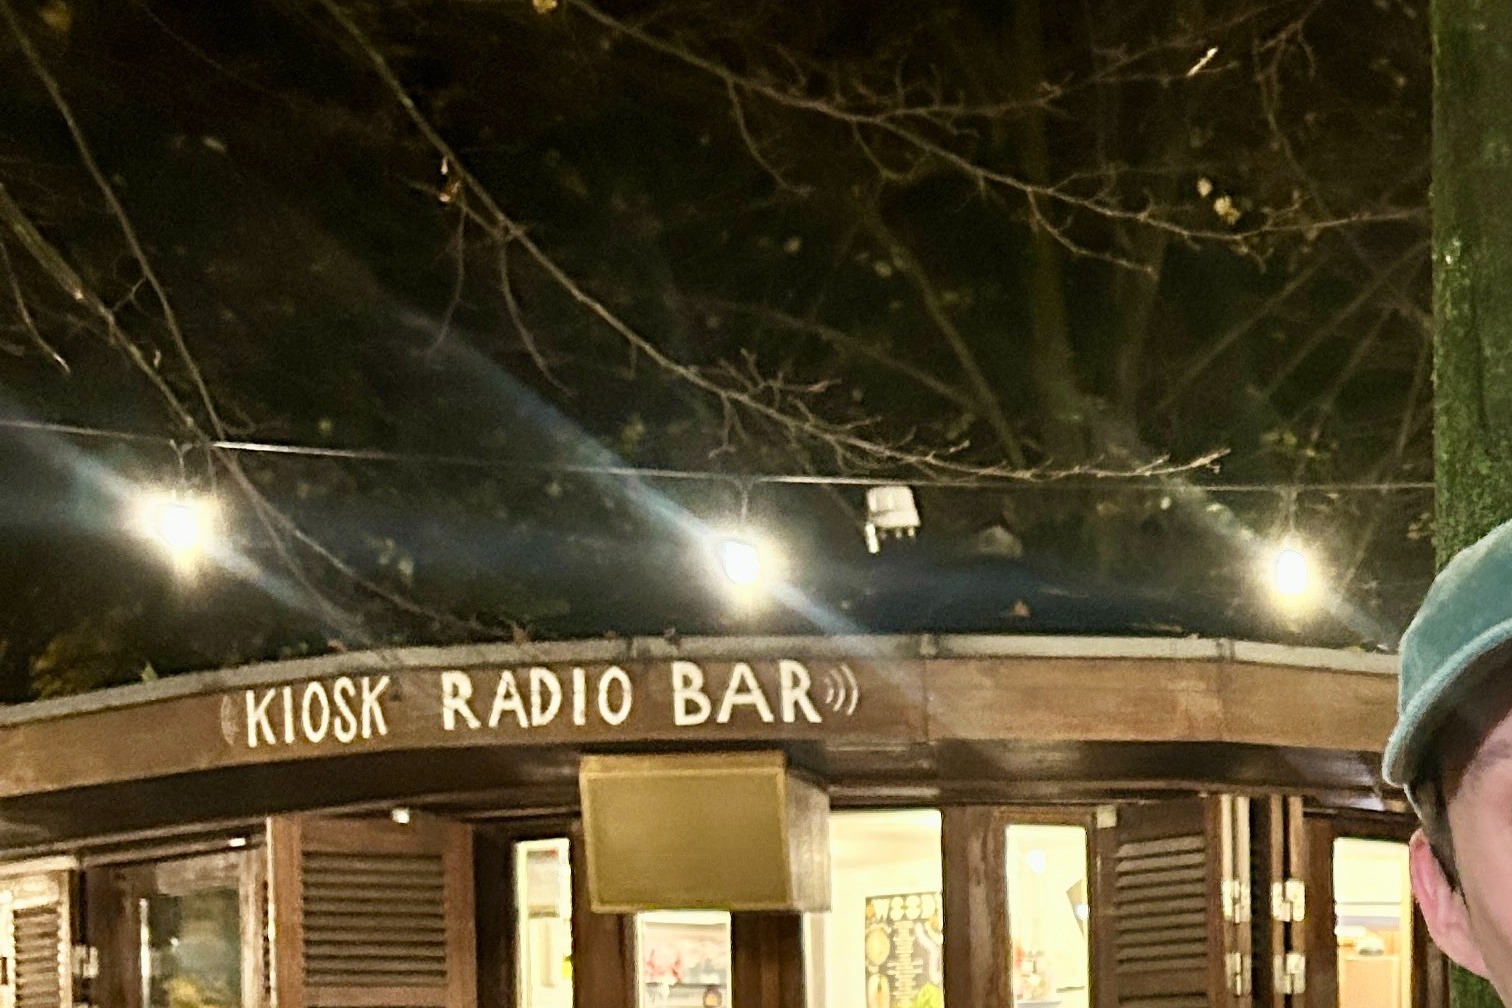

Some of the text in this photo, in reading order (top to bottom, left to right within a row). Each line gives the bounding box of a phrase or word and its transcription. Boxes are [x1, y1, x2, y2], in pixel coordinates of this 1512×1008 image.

[246, 659, 823, 748] KIOSK RADIO BAR
